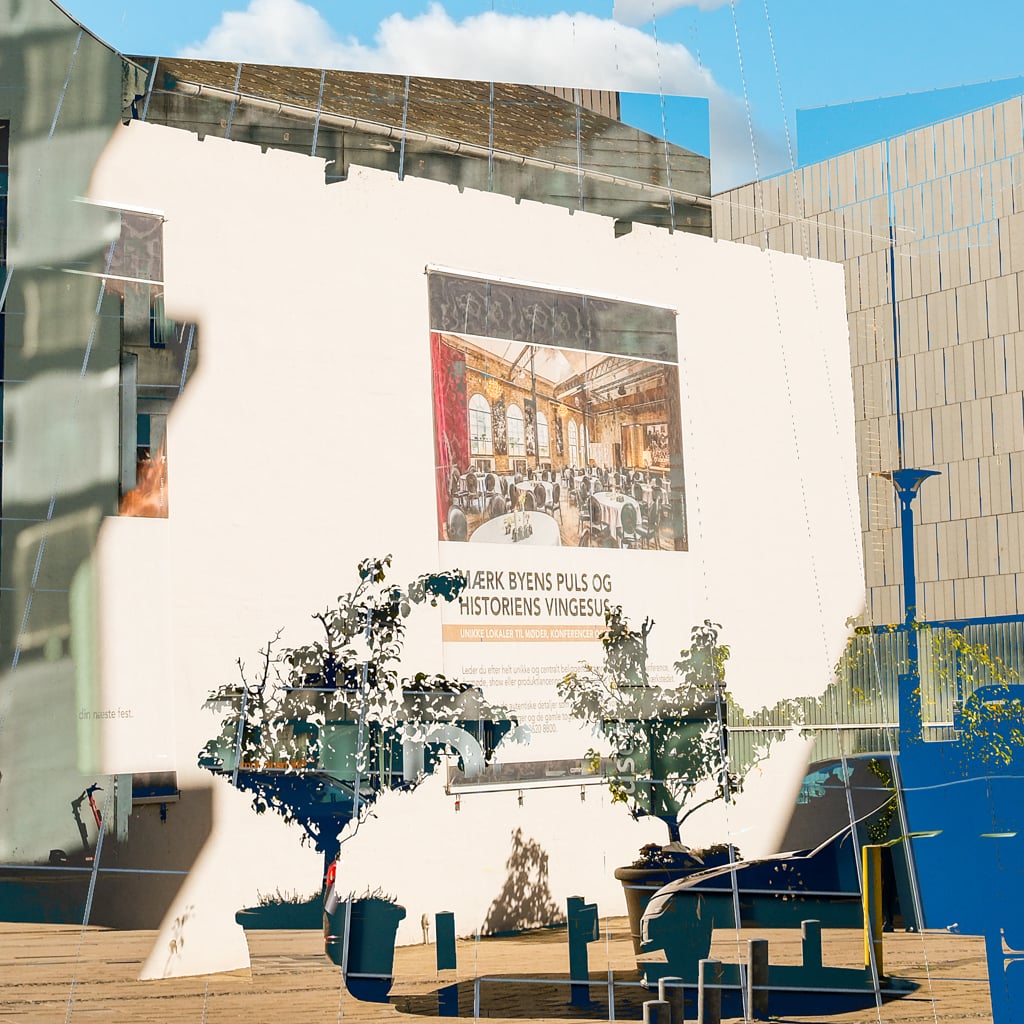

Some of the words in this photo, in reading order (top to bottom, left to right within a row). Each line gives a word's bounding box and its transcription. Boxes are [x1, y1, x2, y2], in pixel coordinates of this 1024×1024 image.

[508, 571, 553, 591] BYENS
[556, 573, 588, 592] PULS
[592, 573, 612, 593] OG
[459, 596, 541, 617] HISTORIENS
[460, 629, 485, 638] UNIKKE
[486, 629, 514, 638] LOKALER
[515, 629, 524, 638] TIL
[551, 629, 593, 639] KONFERENCER
[78, 707, 91, 720] din
[93, 709, 116, 719] næste
